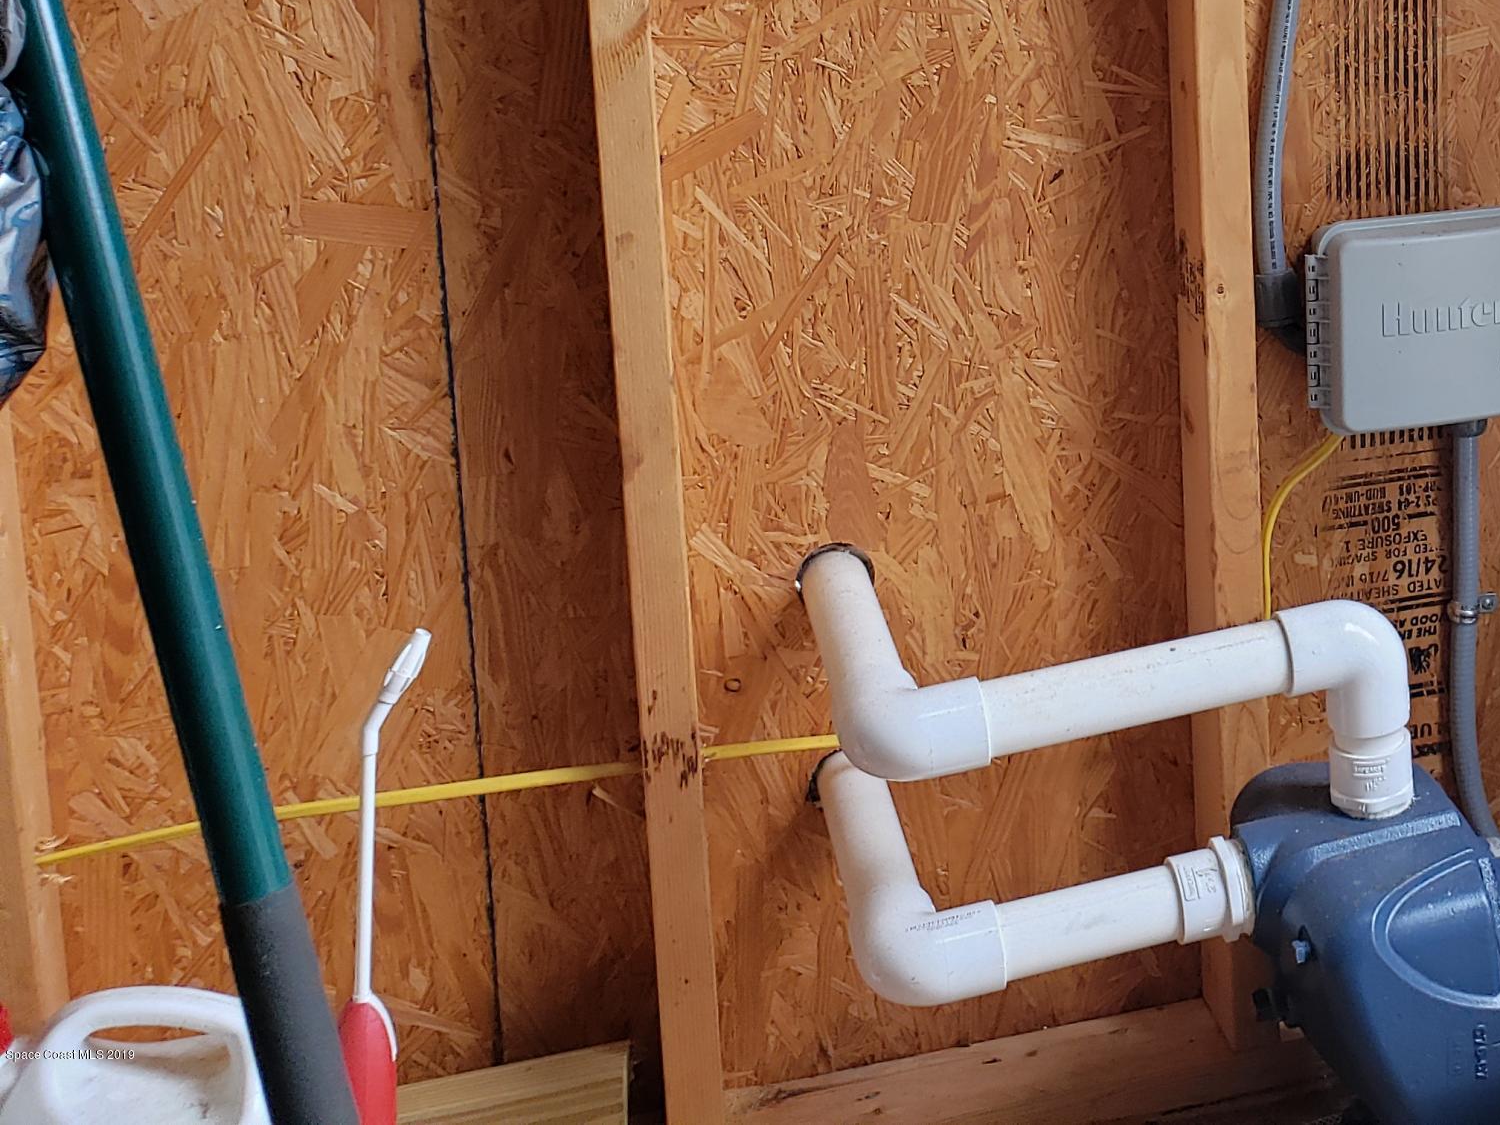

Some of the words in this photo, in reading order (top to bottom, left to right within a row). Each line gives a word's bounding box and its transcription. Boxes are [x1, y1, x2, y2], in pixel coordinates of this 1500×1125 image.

[1371, 515, 1400, 533] 500
[1356, 528, 1428, 549] EXPOSURE
[1343, 540, 1351, 553] 1
[1384, 544, 1409, 559] FOR
[1391, 555, 1448, 580] 24/16
[1359, 569, 1390, 583] 7/16
[1414, 625, 1438, 637] THE
